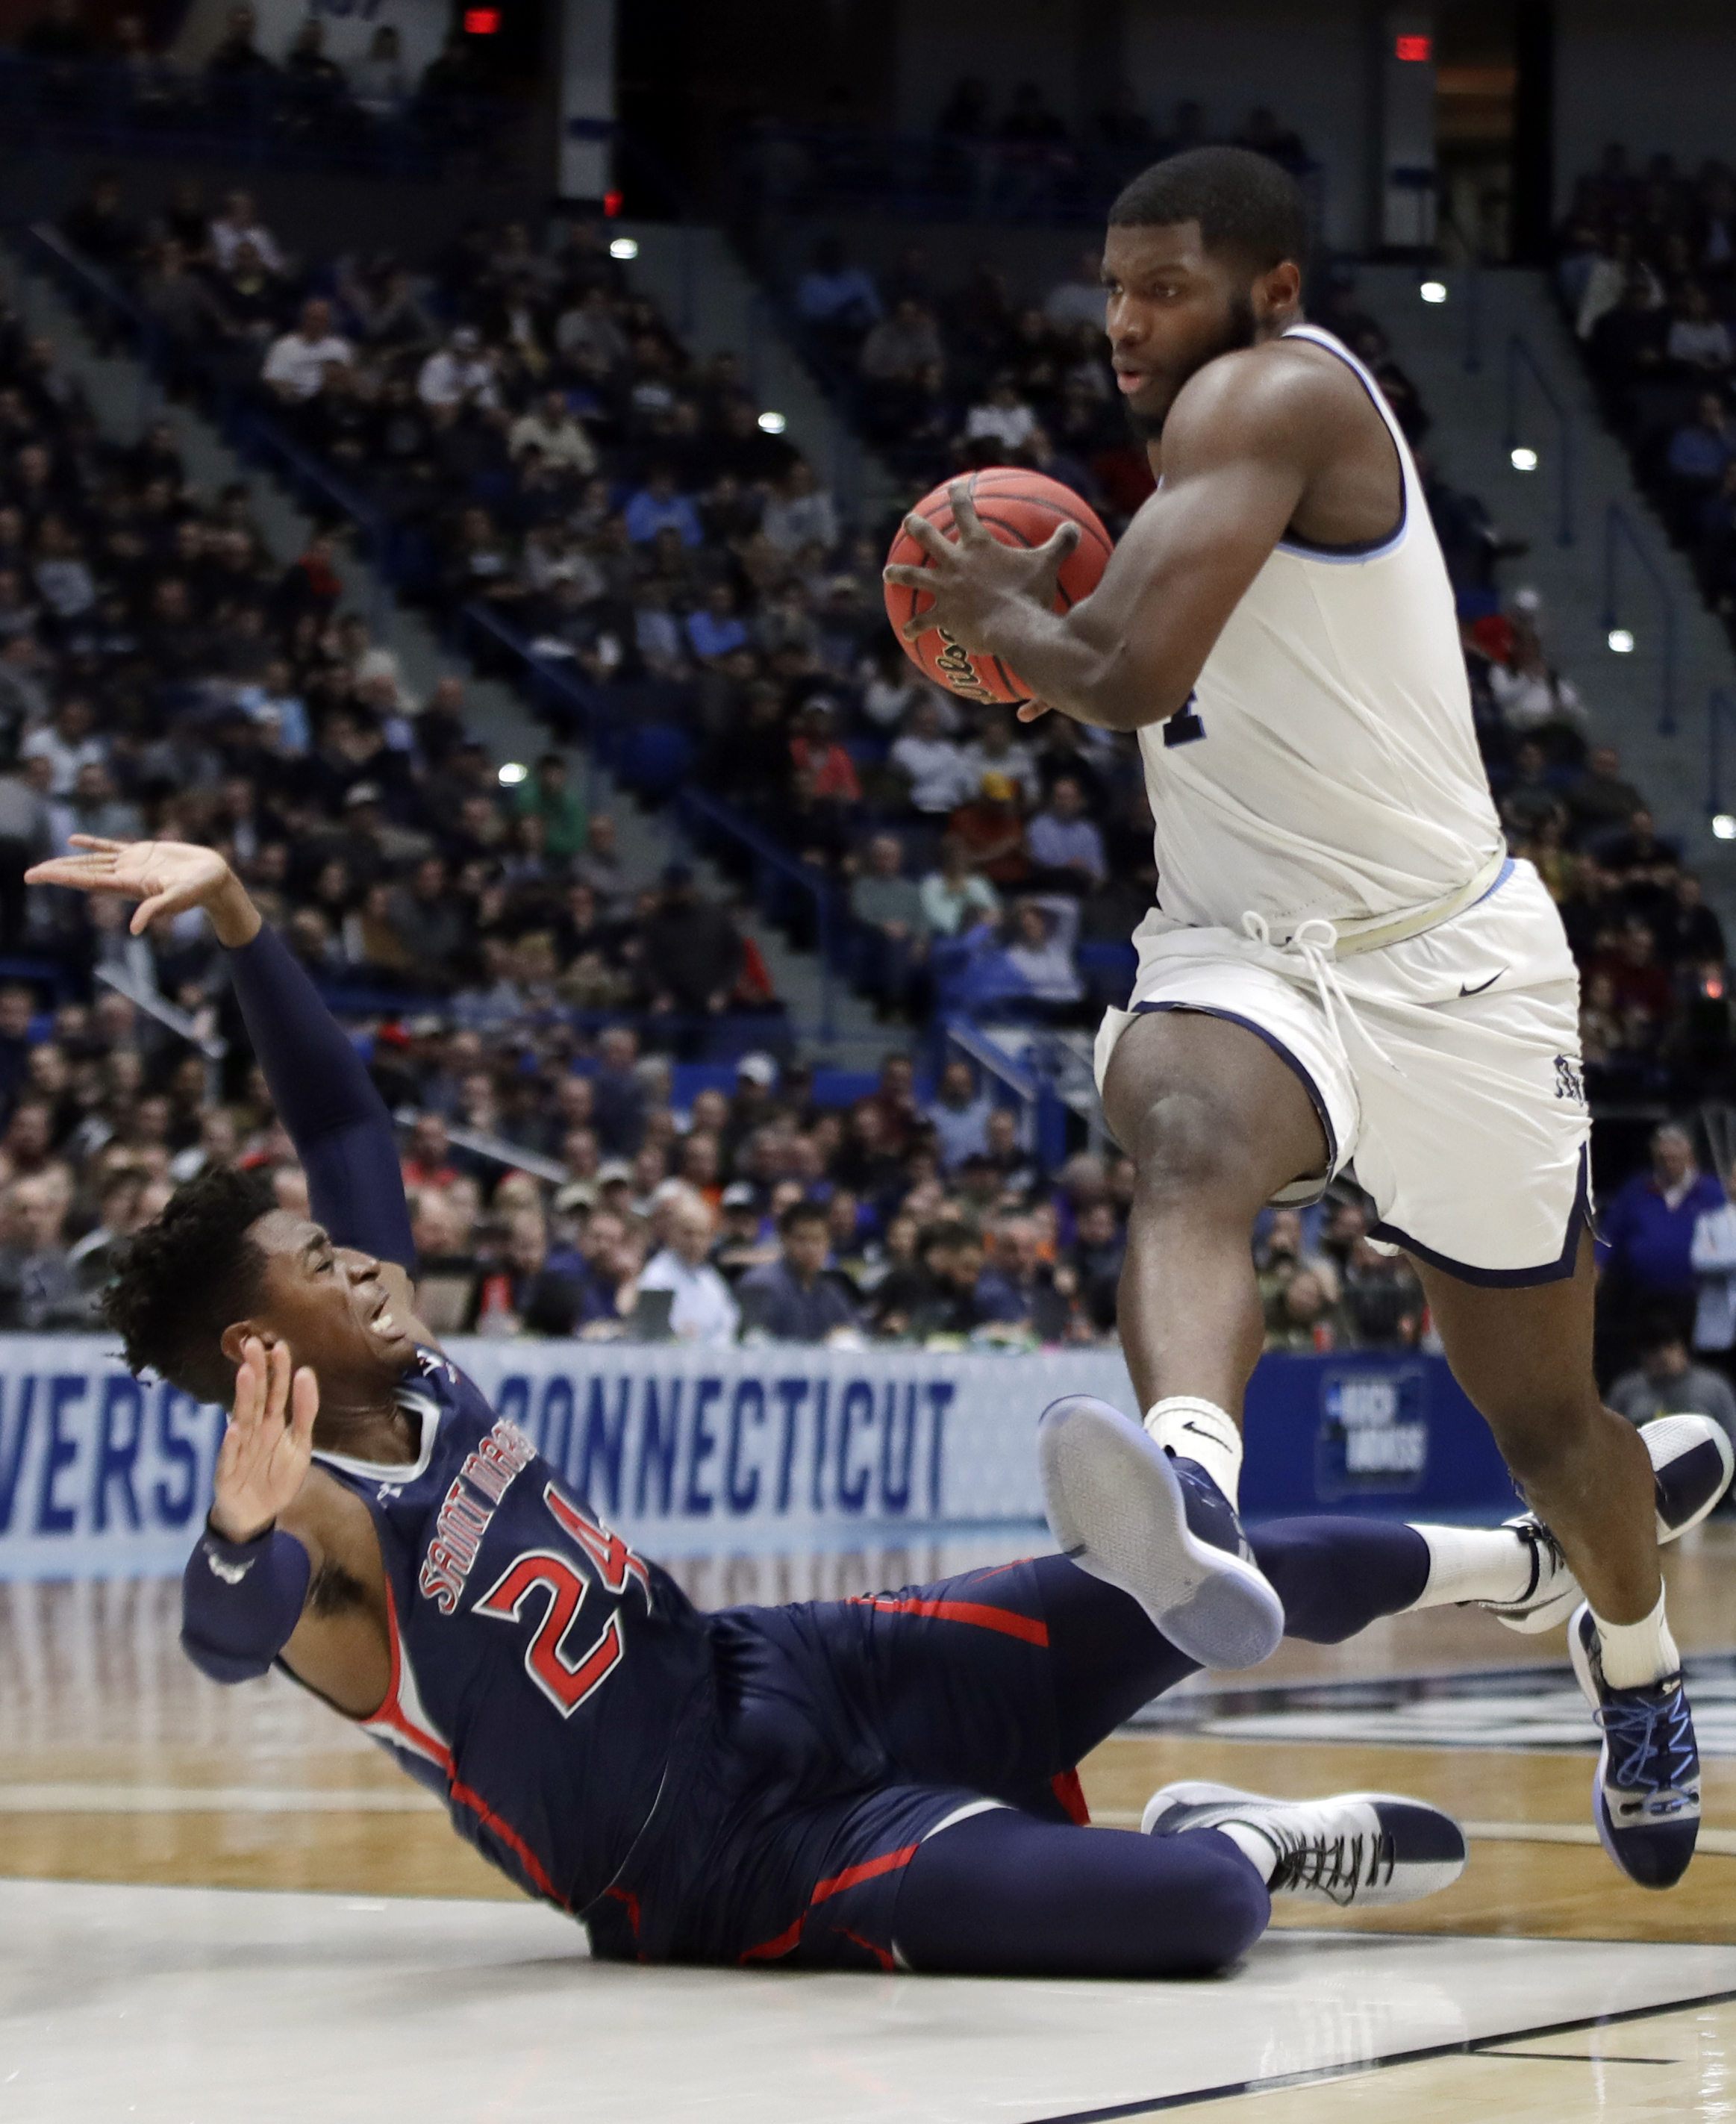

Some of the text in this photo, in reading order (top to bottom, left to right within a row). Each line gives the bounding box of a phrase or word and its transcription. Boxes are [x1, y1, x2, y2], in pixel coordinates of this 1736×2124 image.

[0, 1375, 227, 1533] VERS
[419, 1475, 495, 1615] SAINT
[471, 1481, 653, 1719] 24
